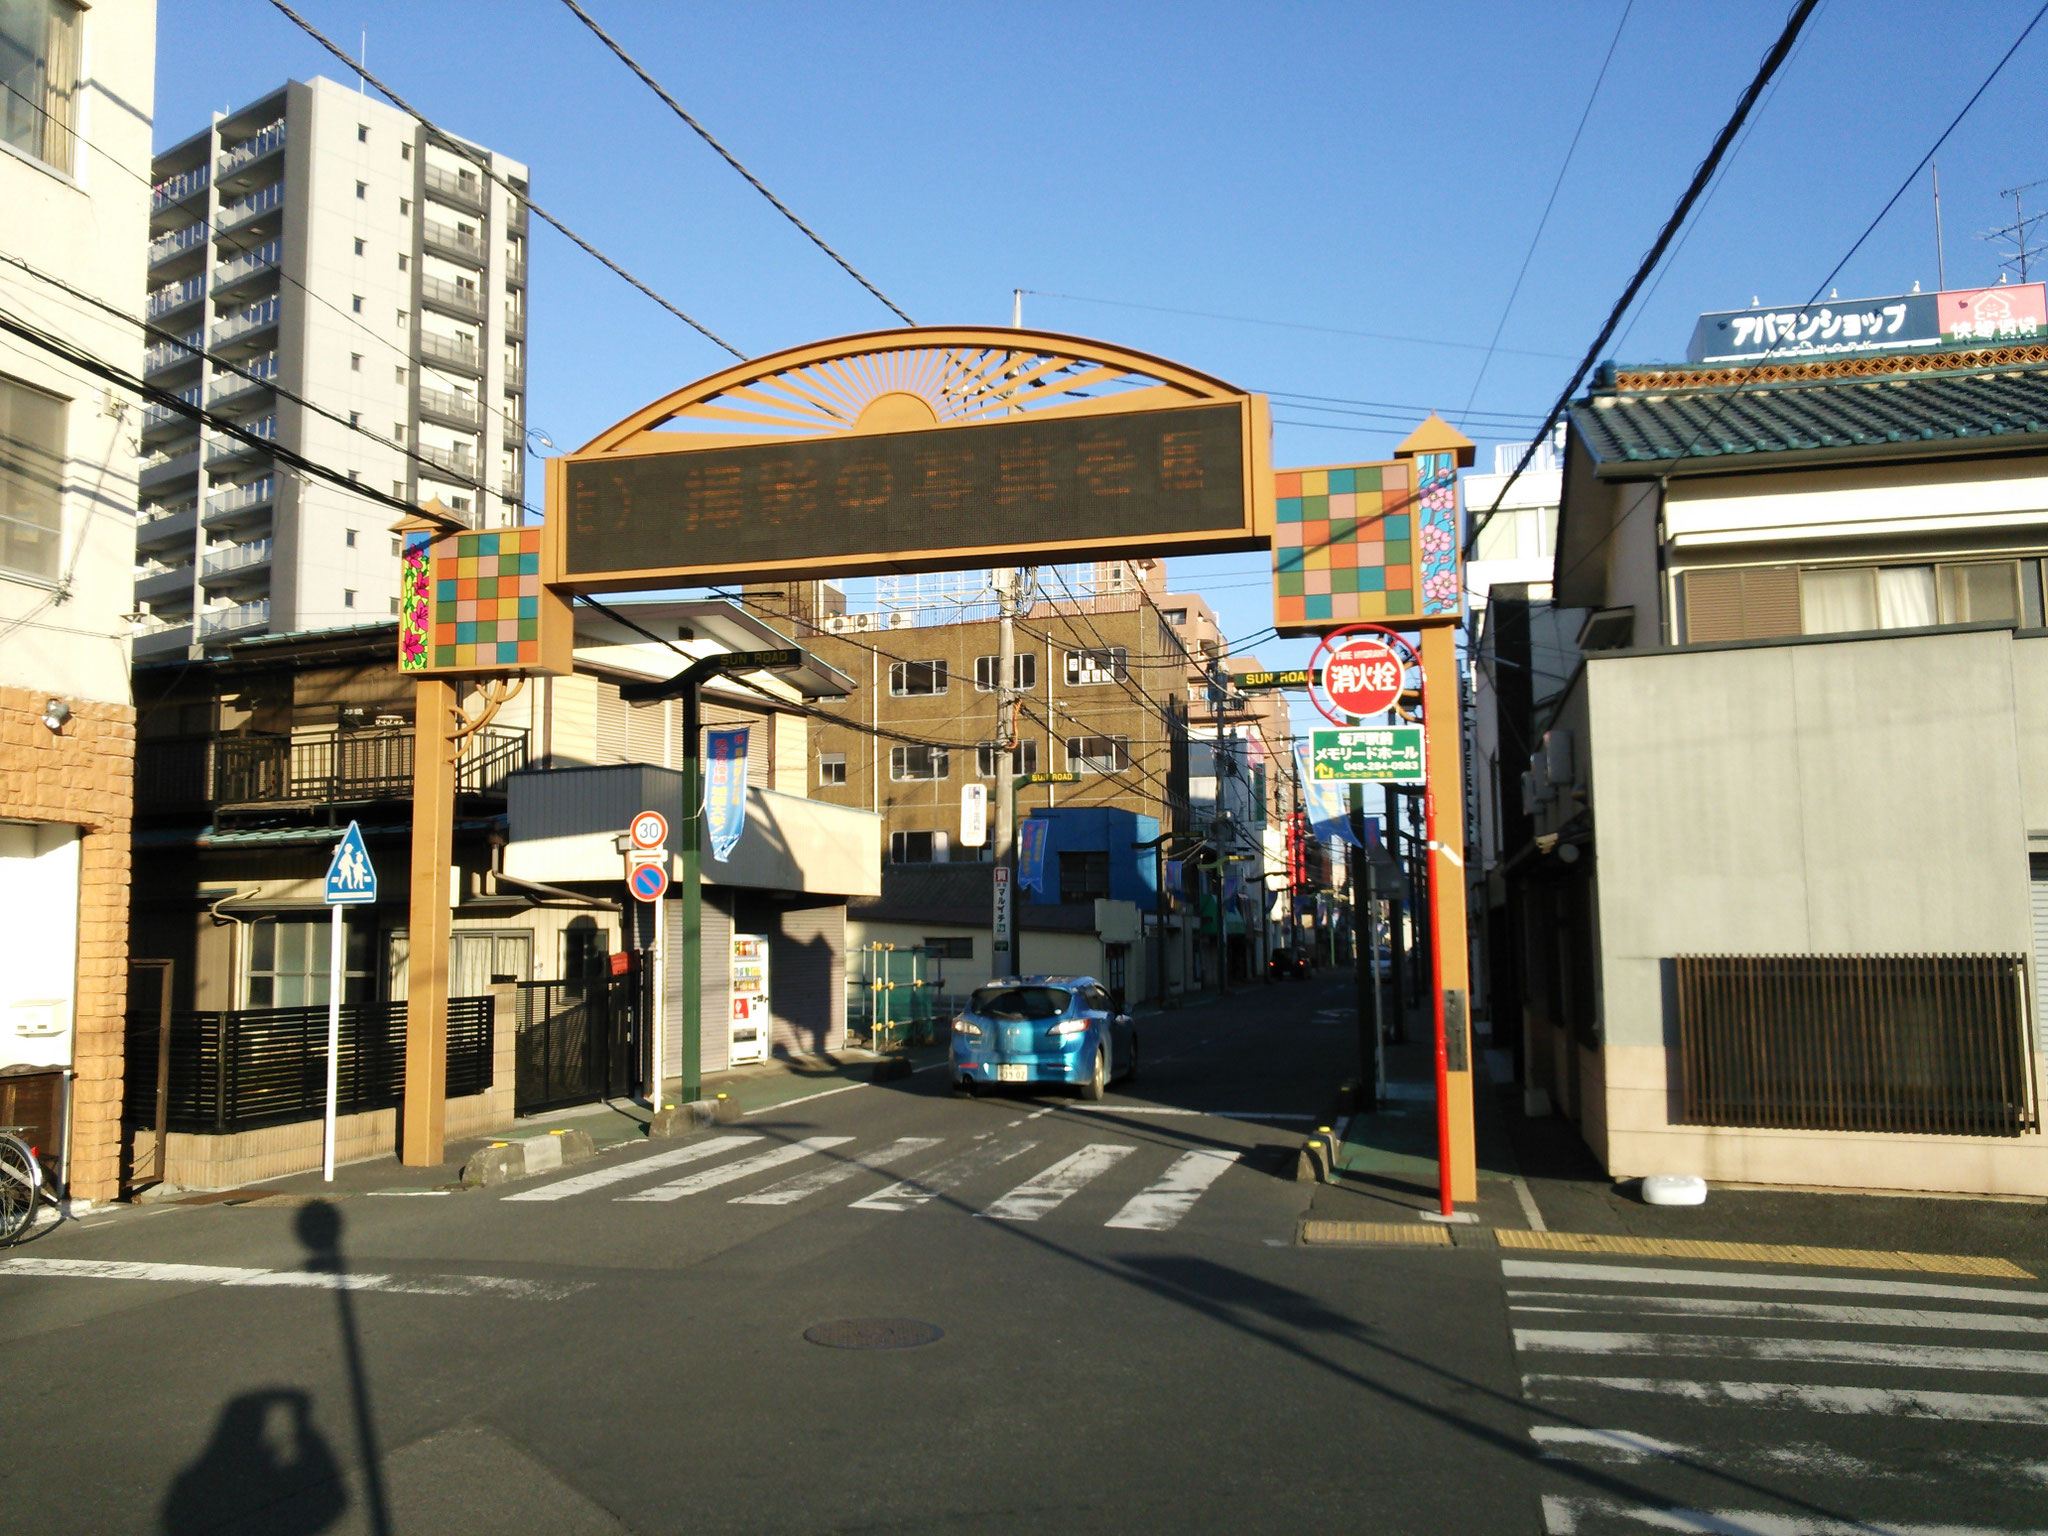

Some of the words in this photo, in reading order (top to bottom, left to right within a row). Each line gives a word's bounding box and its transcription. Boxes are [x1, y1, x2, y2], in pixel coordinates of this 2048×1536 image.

[1731, 303, 1907, 346] アパマンショップ
[720, 654, 747, 666] SUN
[754, 651, 788, 663] ROAD
[1246, 673, 1273, 684] SUN
[1330, 661, 1397, 694] 消火栓
[1314, 745, 1419, 761] メモリードホール
[1052, 773, 1073, 781] ROAD
[639, 822, 659, 839] 30
[997, 888, 1006, 922] マルイチ
